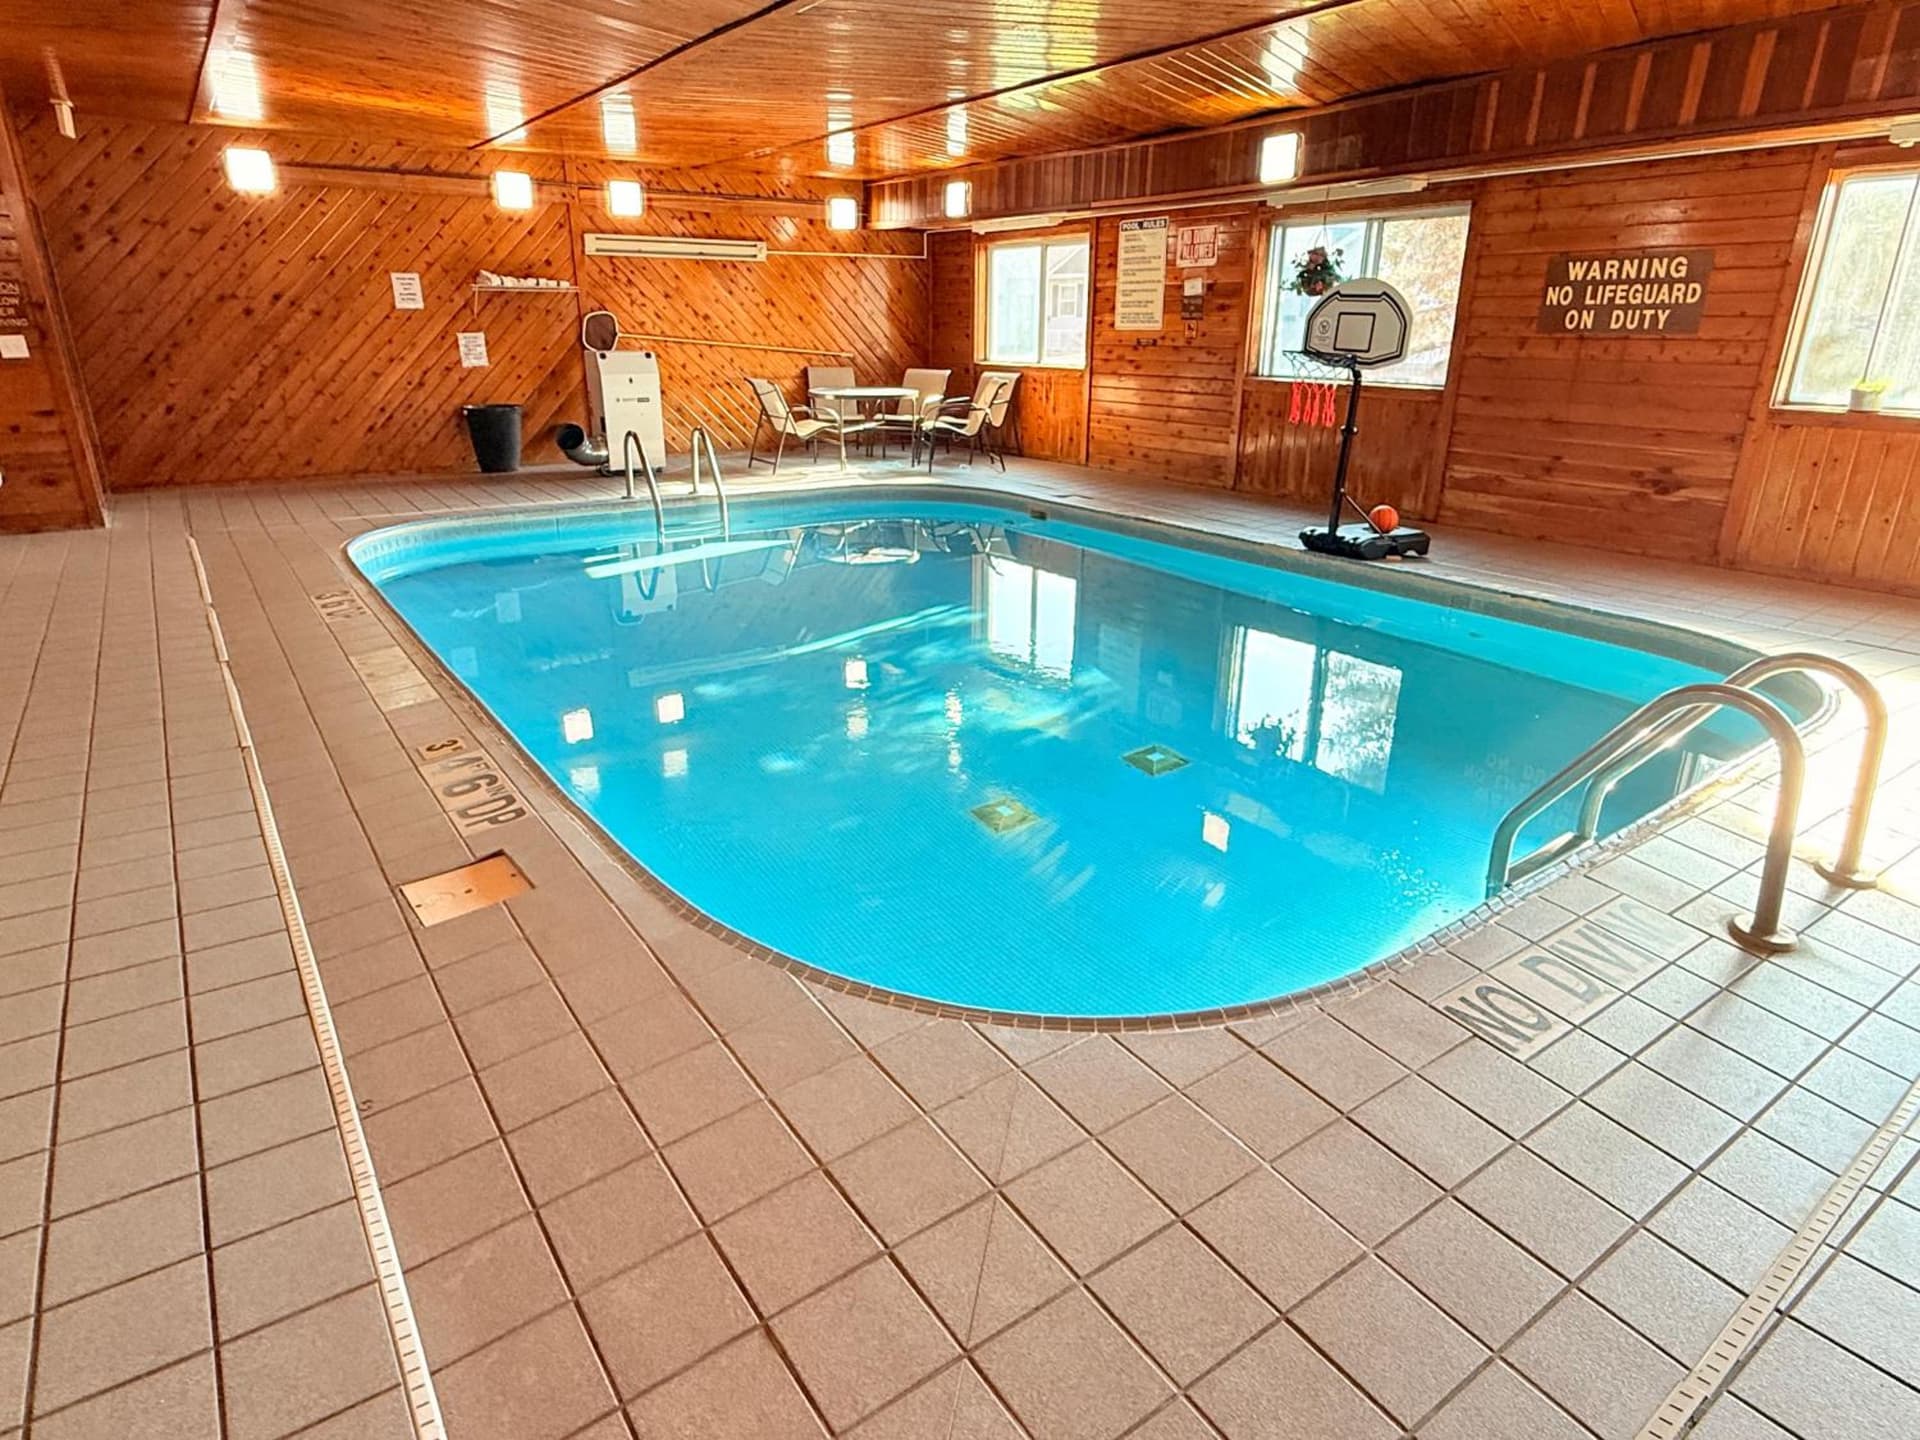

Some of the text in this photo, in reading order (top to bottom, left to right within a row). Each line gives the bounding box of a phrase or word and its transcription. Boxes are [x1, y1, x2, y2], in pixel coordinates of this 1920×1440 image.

[1122, 219, 1165, 230] POOL RULES
[1568, 256, 1688, 281] WARNING
[1545, 283, 1702, 306] NO LIFEGUARD
[1565, 309, 1671, 330] ON DUTY
[1442, 985, 1551, 1053] NO
